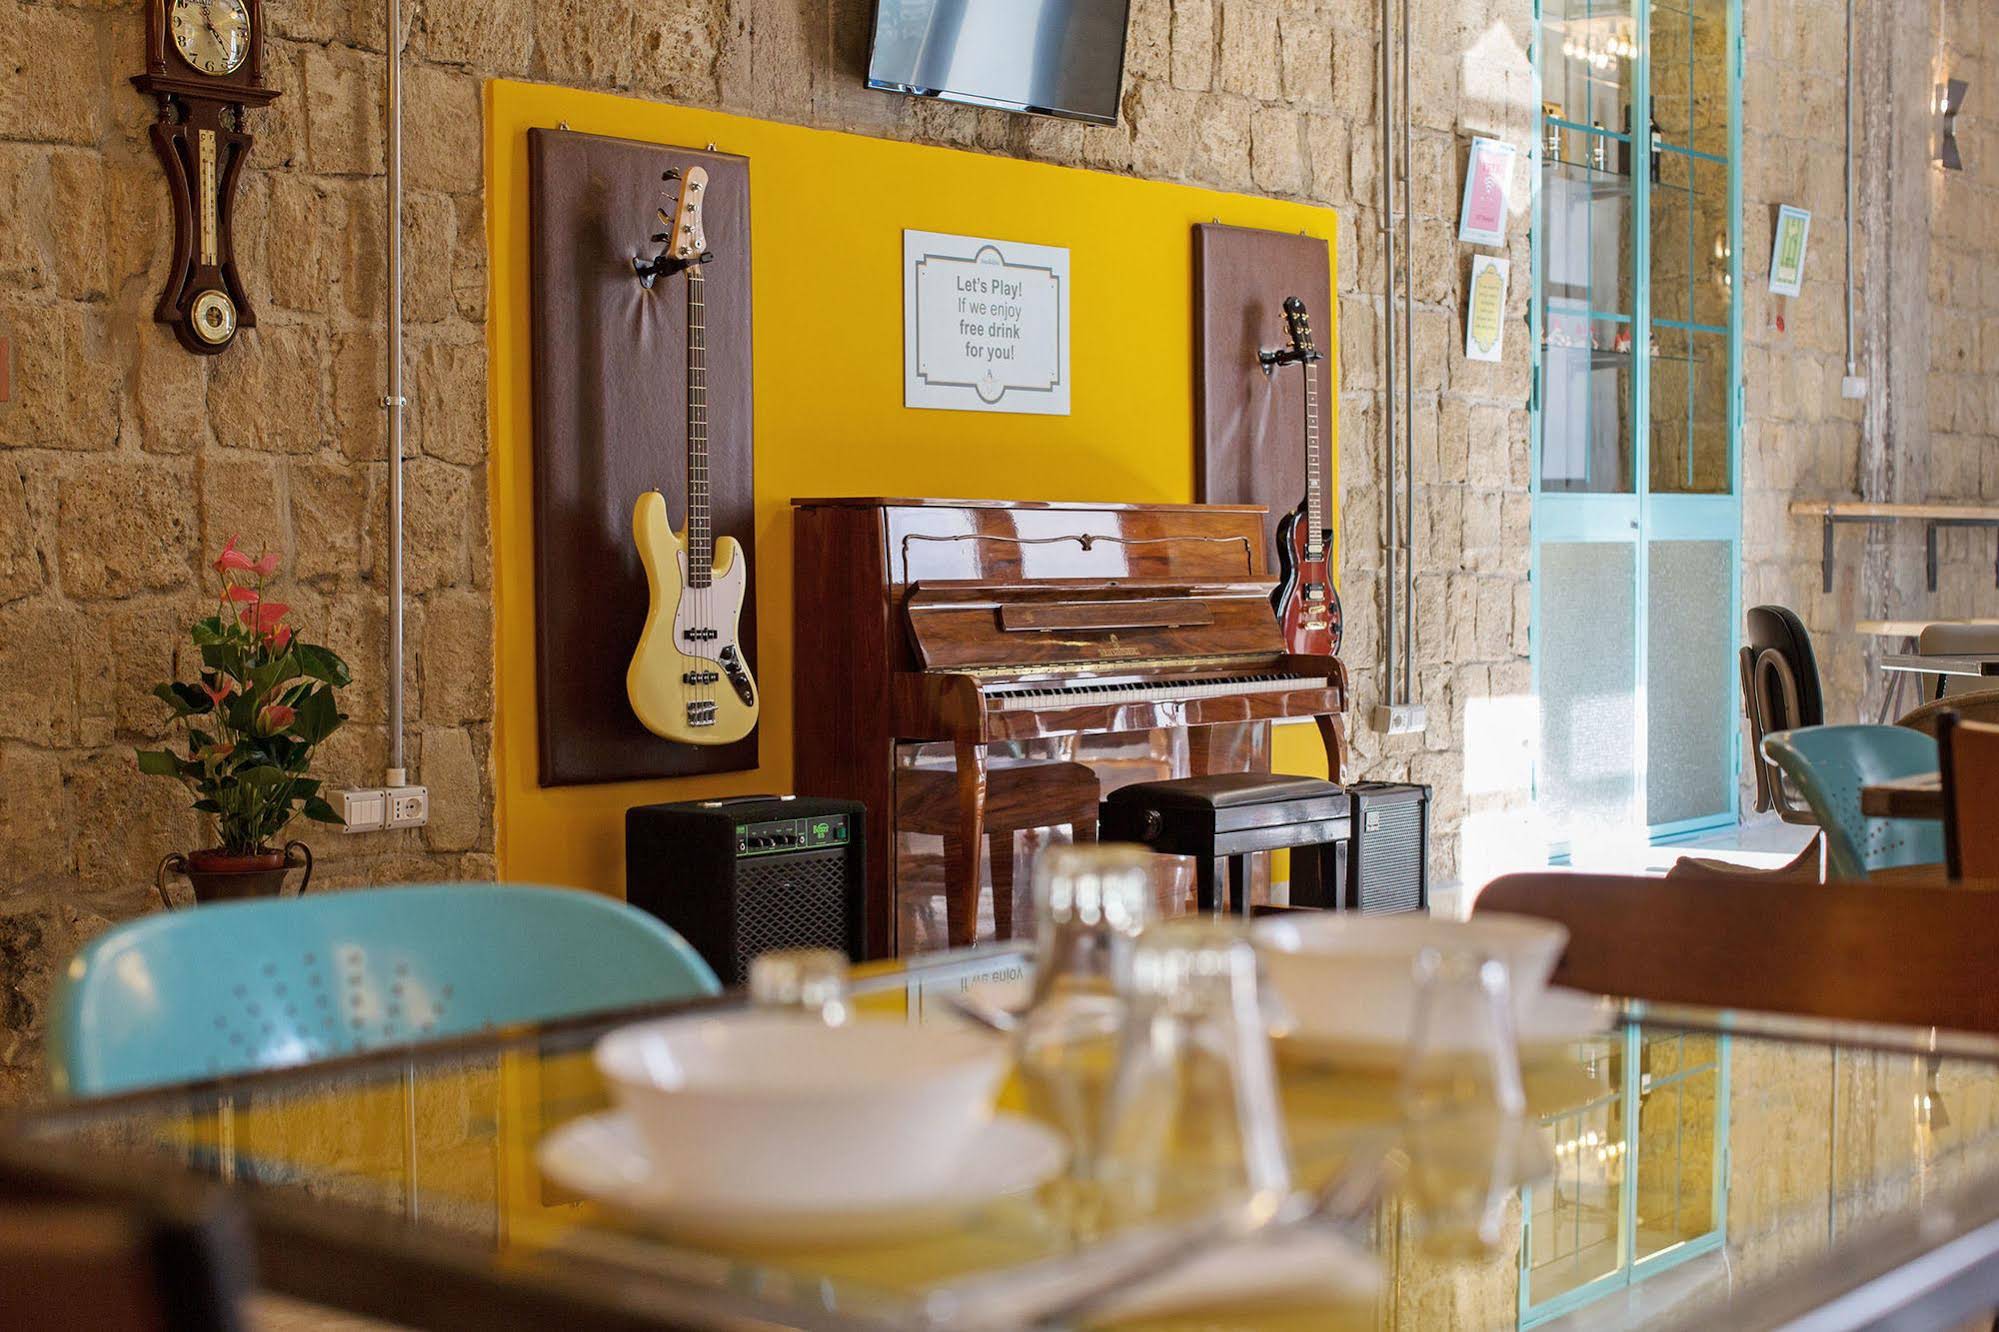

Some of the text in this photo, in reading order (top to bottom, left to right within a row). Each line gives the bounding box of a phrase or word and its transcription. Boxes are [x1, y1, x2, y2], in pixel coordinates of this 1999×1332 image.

[174, 16, 182, 28] 9
[178, 36, 186, 47] 8
[189, 52, 198, 64] 7
[205, 61, 214, 72] 6
[957, 275, 1022, 300] Let's Play!
[958, 297, 1021, 321] If we enjoy
[959, 319, 1020, 339] free drink
[965, 341, 1015, 362] for you!
